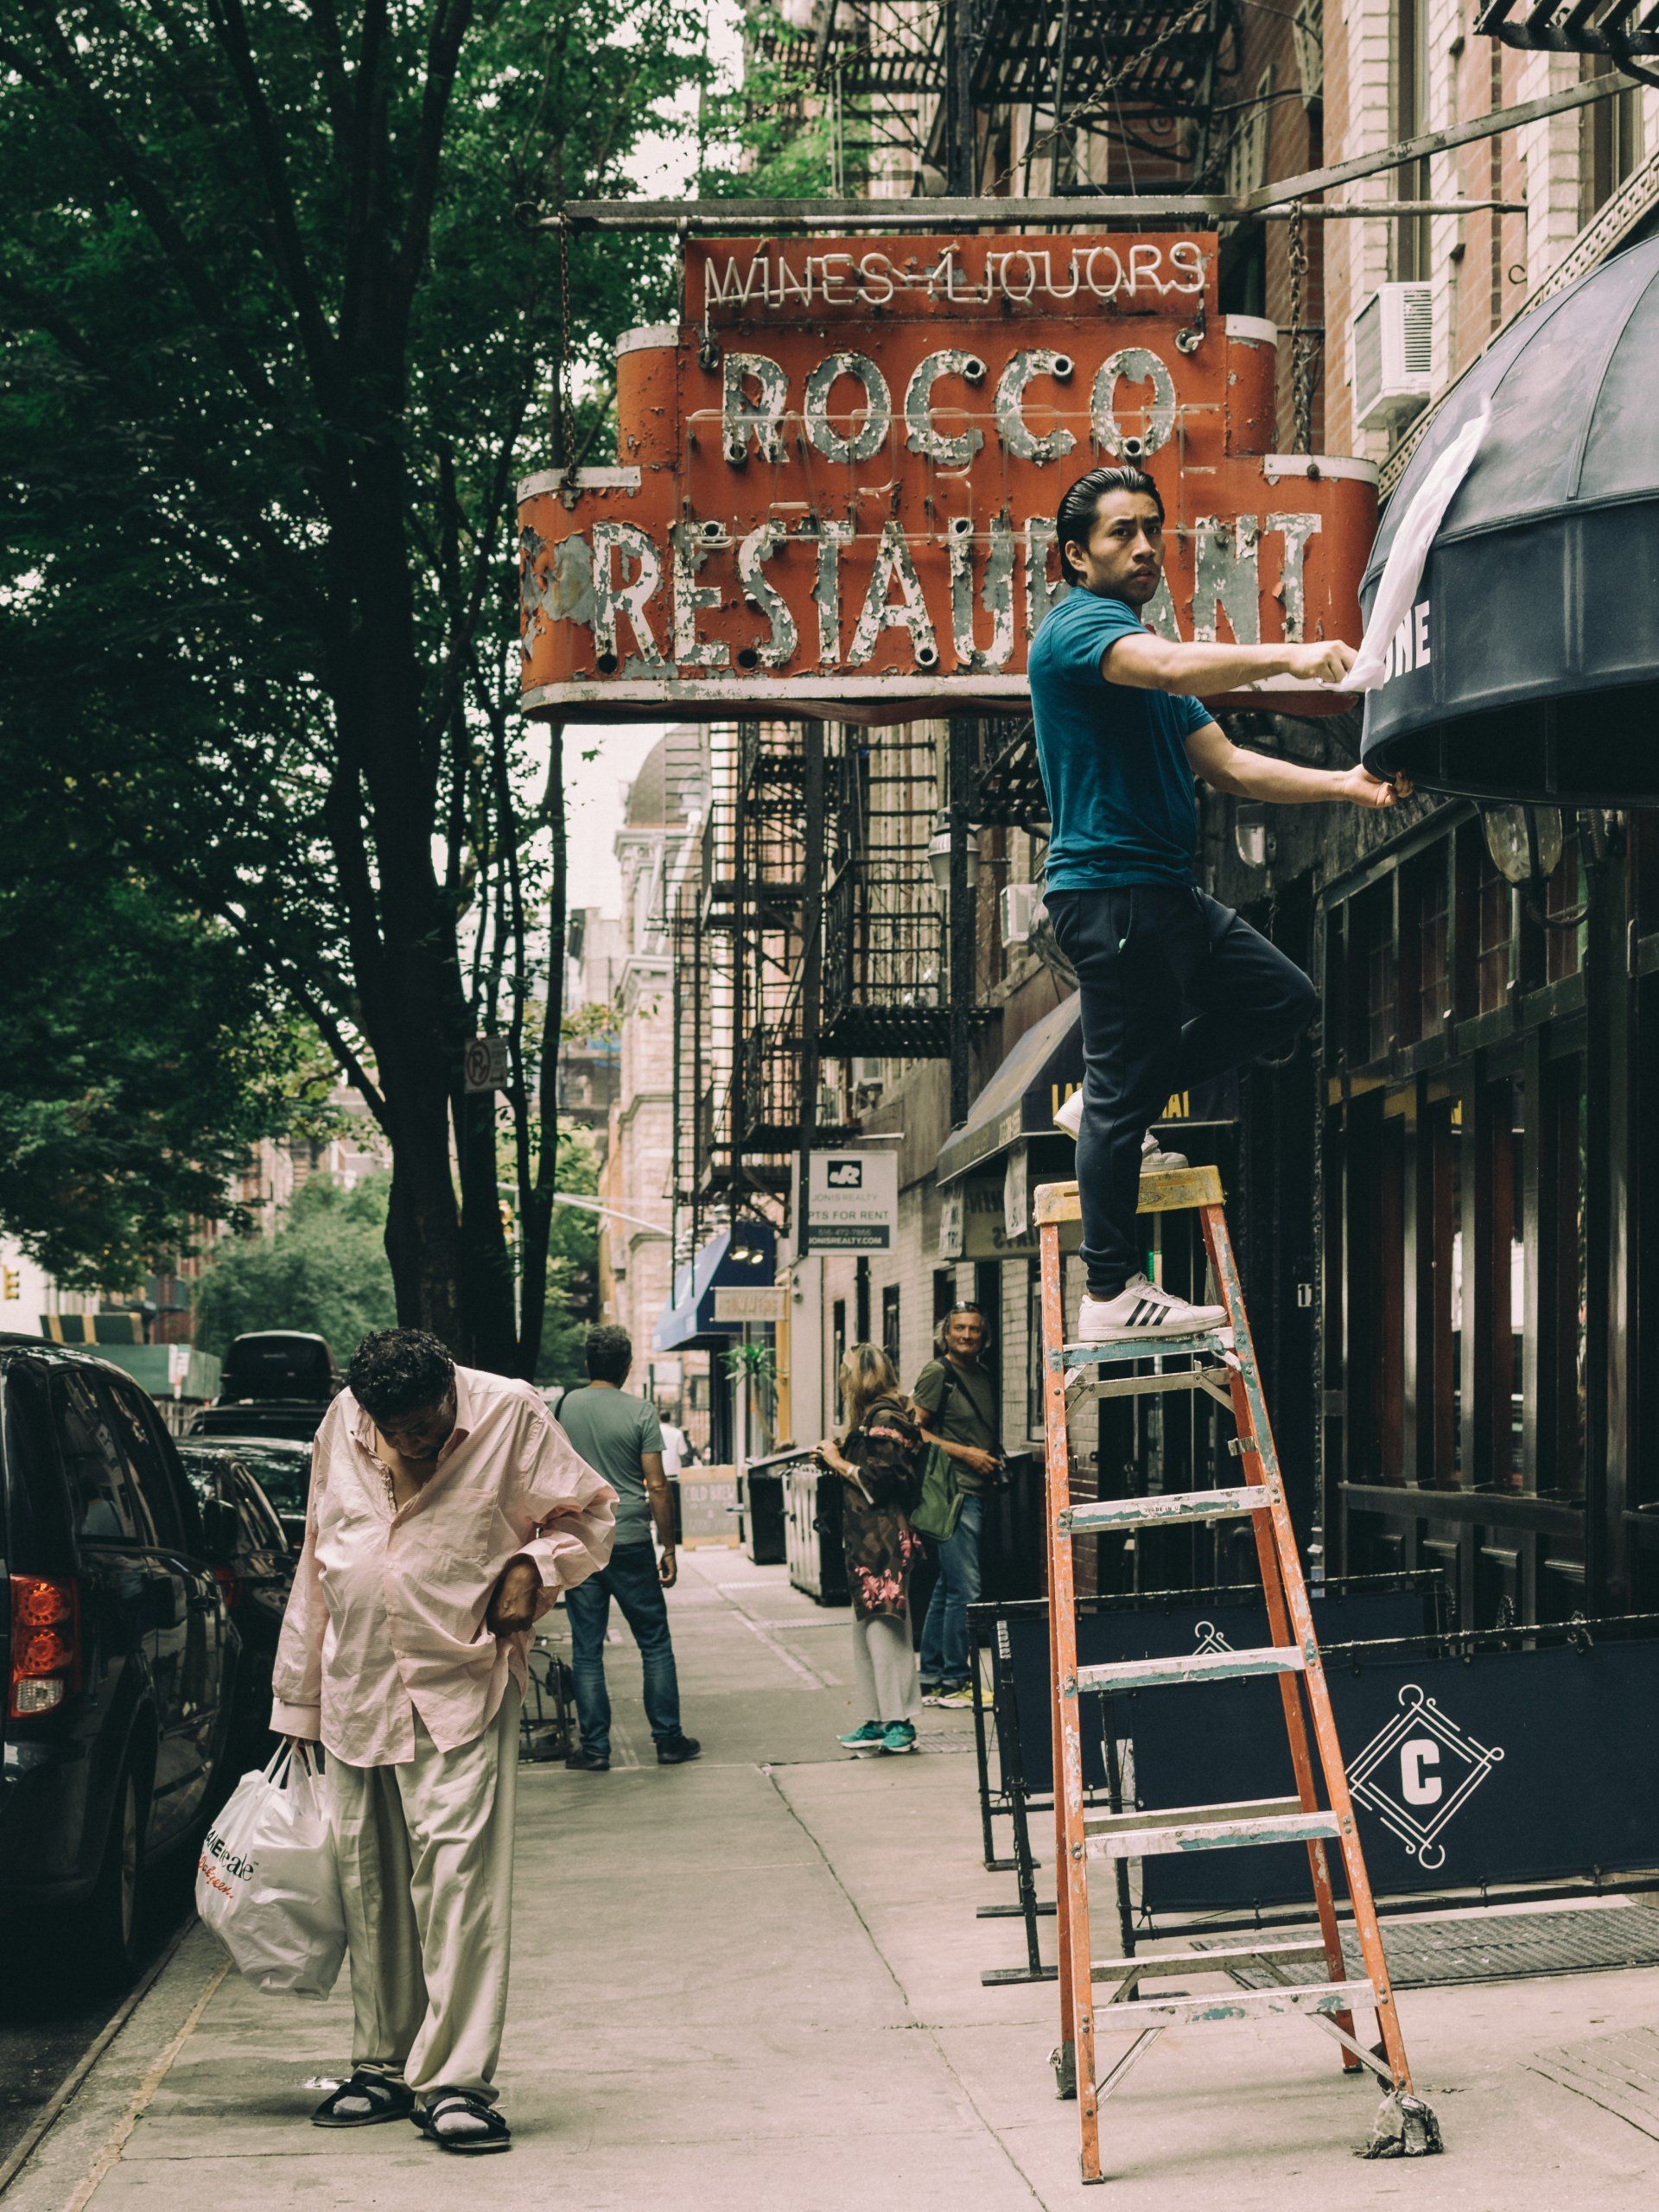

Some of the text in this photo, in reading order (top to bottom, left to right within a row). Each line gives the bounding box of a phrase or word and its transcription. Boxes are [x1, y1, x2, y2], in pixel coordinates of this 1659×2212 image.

[722, 347, 1177, 467] ROCCO
[809, 1211, 888, 1220] PTS FOR RENT
[1400, 1738, 1443, 1806] C
